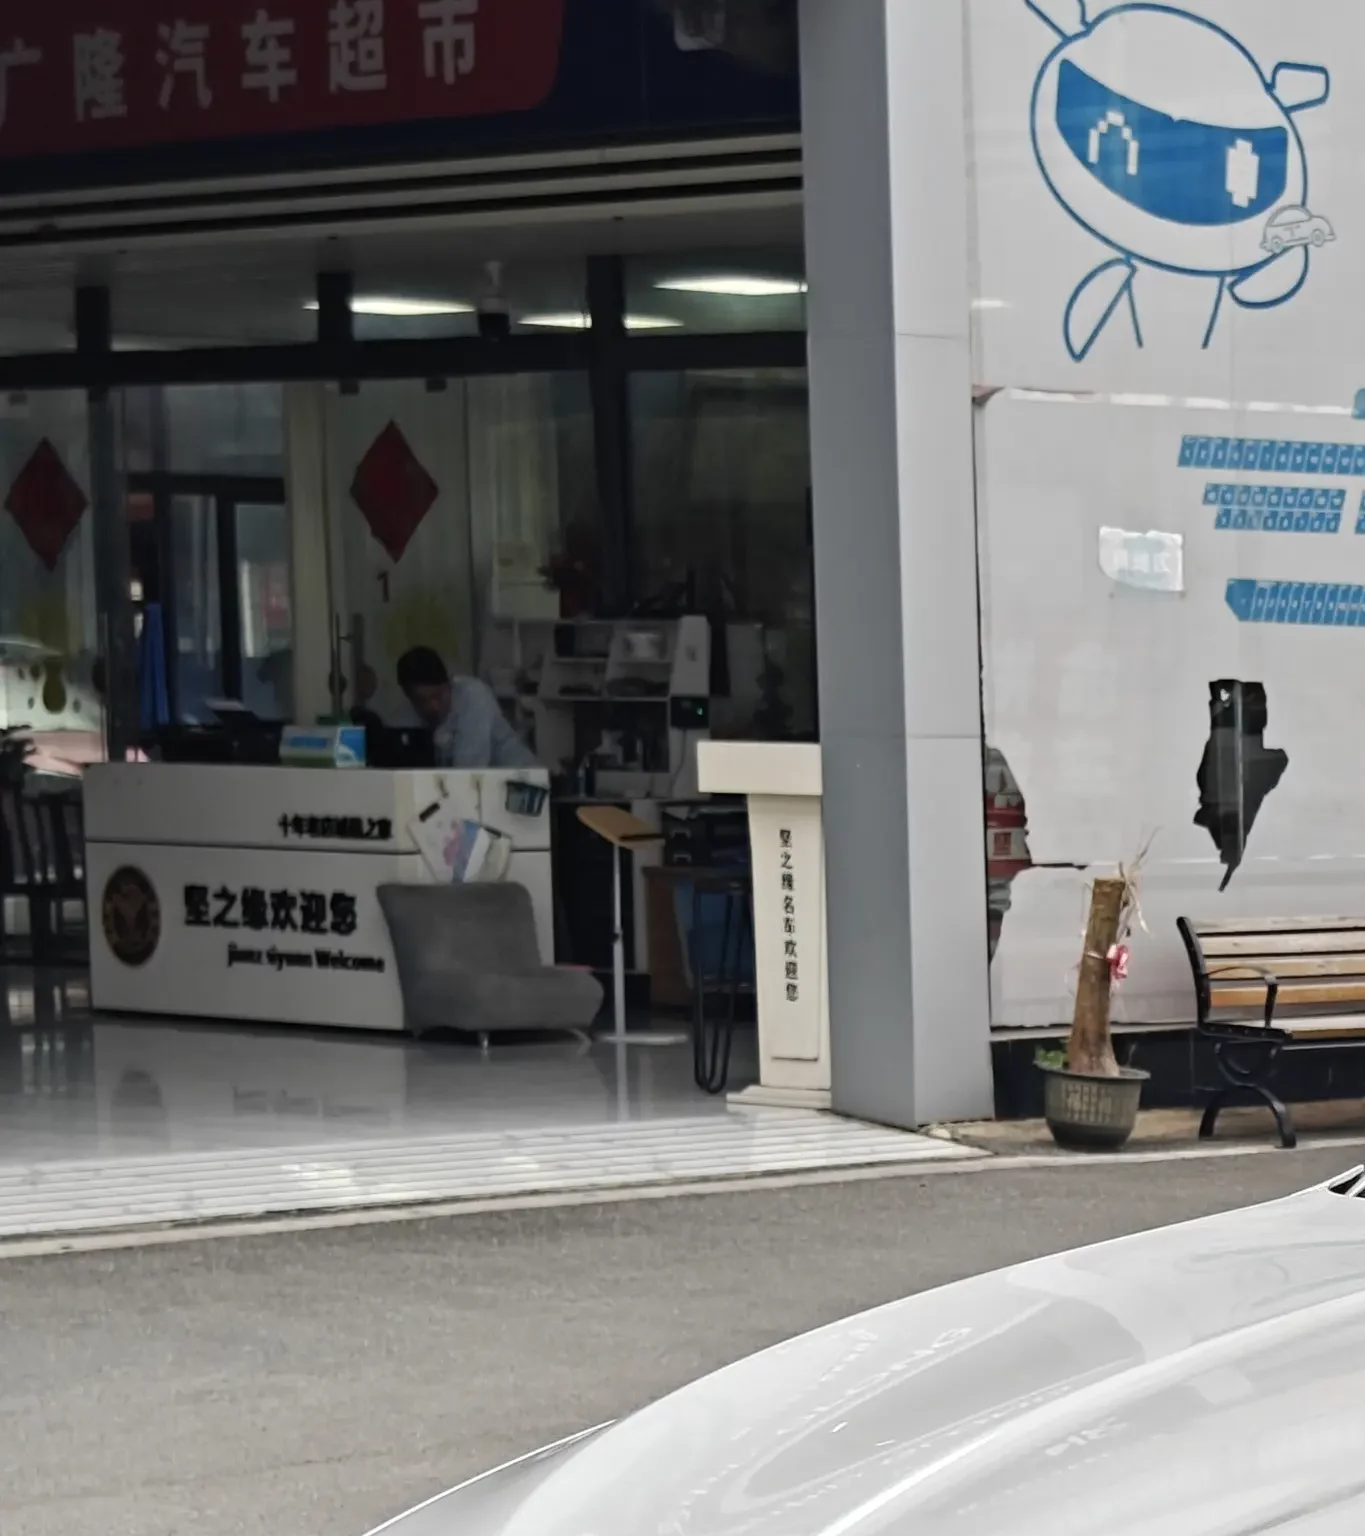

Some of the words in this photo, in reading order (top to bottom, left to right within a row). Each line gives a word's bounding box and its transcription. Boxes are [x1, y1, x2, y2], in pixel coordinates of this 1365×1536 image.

[0, 0, 479, 126] 广隆汽车超市
